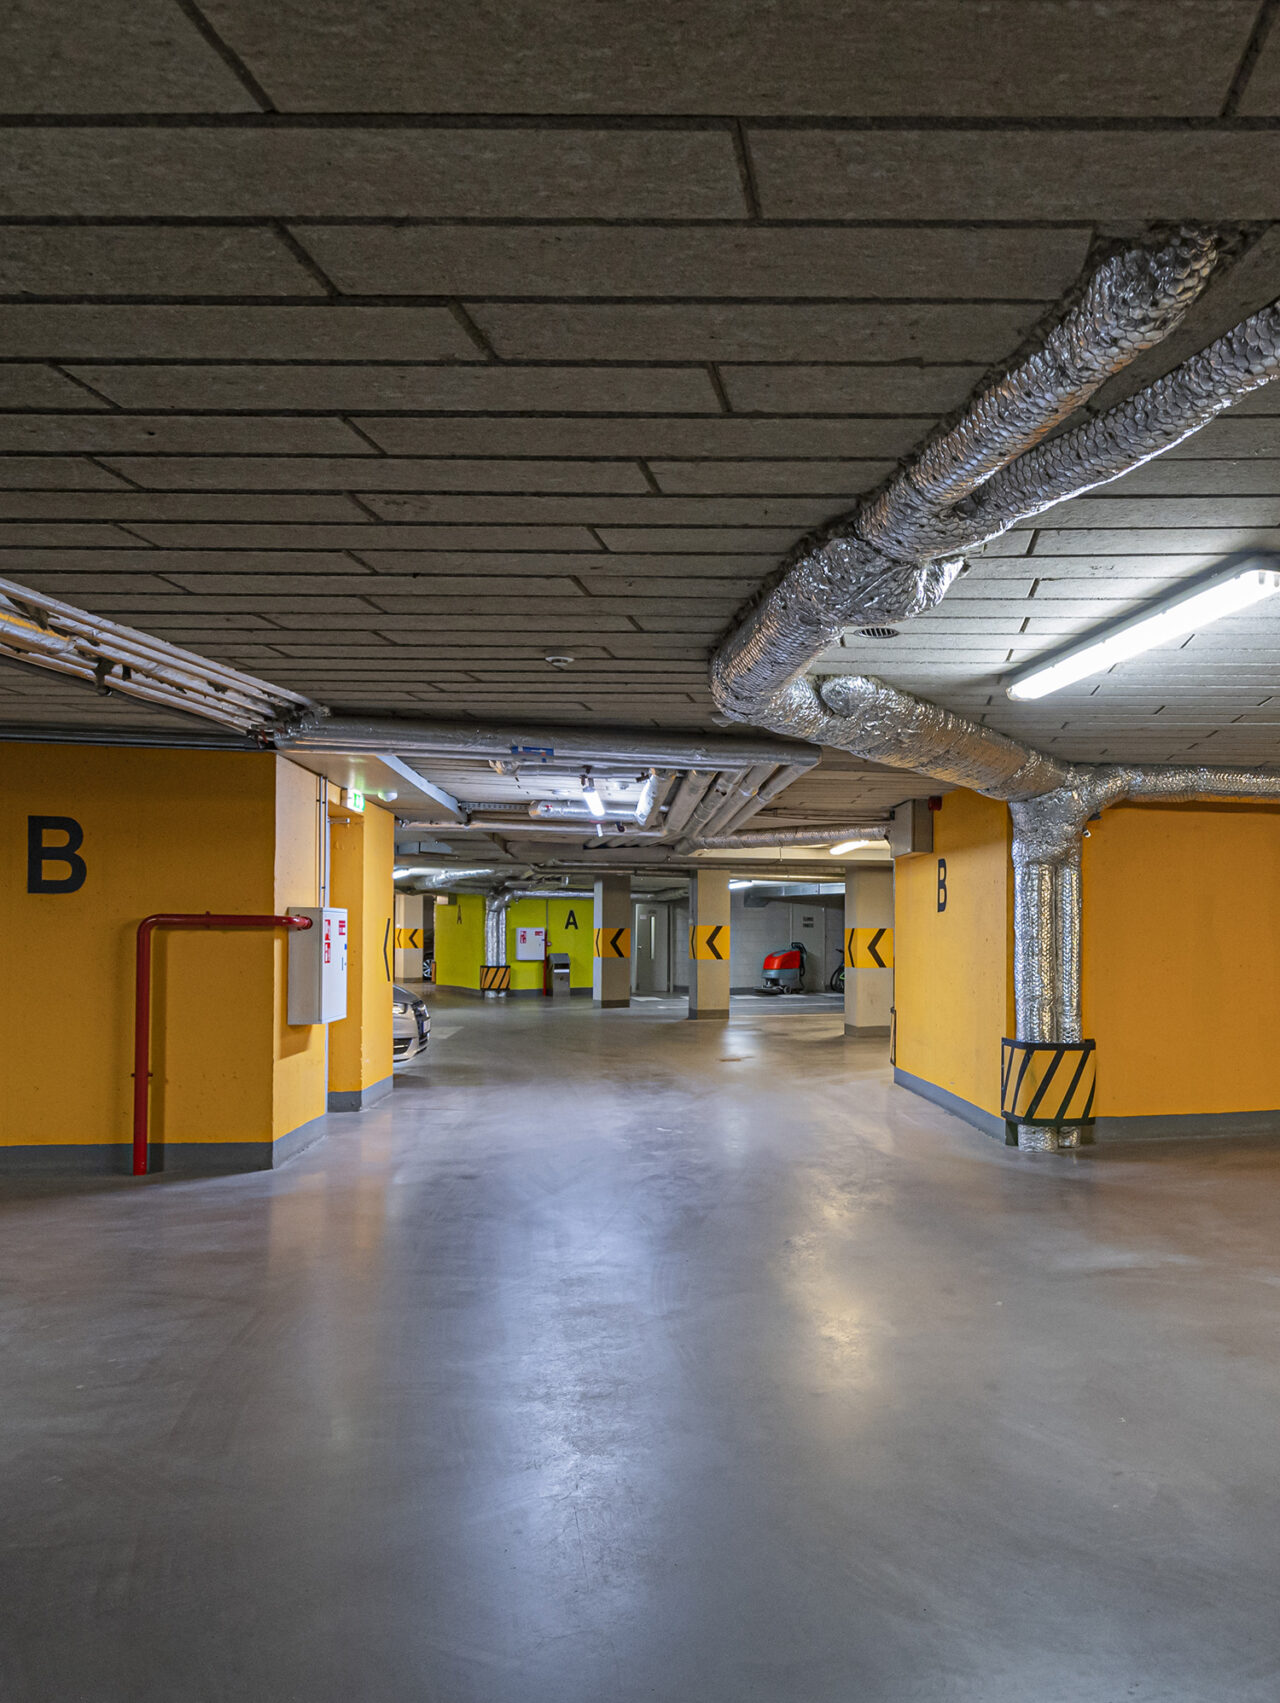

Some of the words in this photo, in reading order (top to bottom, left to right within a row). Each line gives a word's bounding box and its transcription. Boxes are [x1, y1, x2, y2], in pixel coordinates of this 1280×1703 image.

[27, 815, 87, 894] B
[937, 858, 947, 913] B
[565, 909, 578, 929] A
